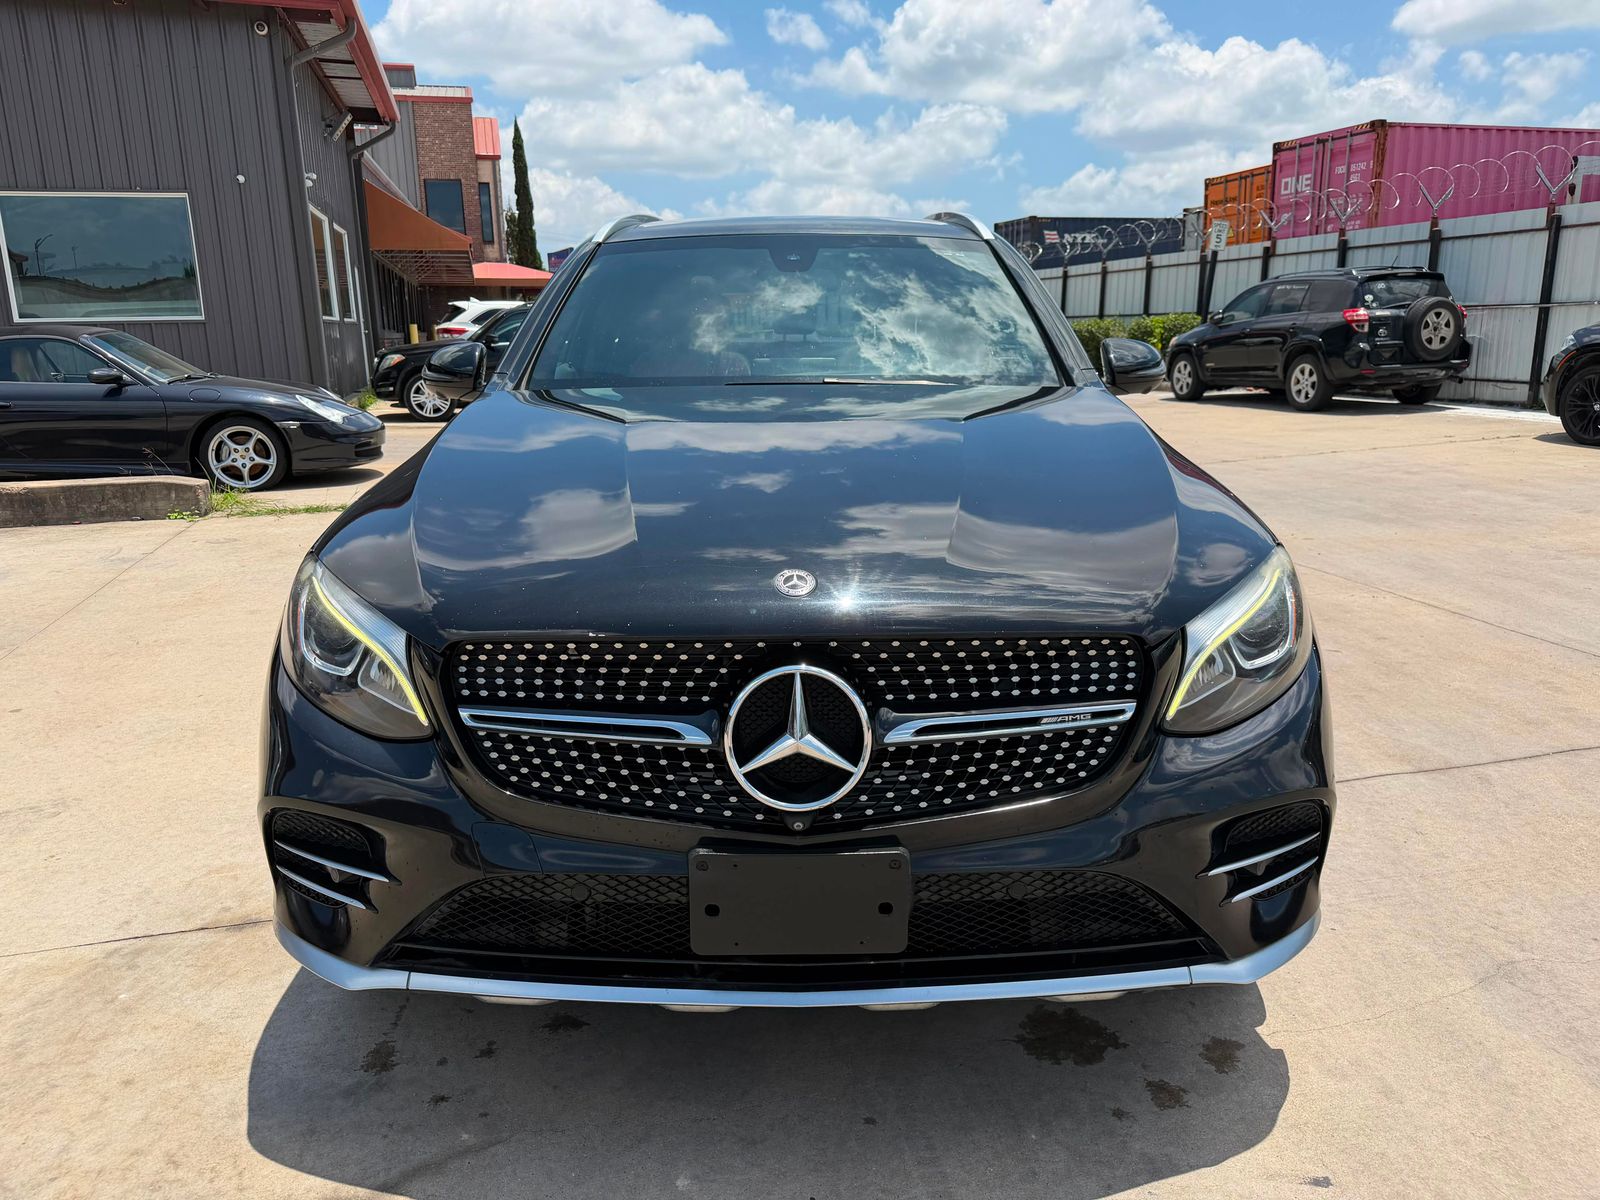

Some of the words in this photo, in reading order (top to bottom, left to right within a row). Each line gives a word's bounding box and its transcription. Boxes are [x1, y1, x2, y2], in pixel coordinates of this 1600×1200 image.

[1281, 174, 1311, 194] ONE
[1062, 233, 1097, 243] NYK
[1215, 233, 1222, 244] 5
[1056, 713, 1091, 722] AMG
